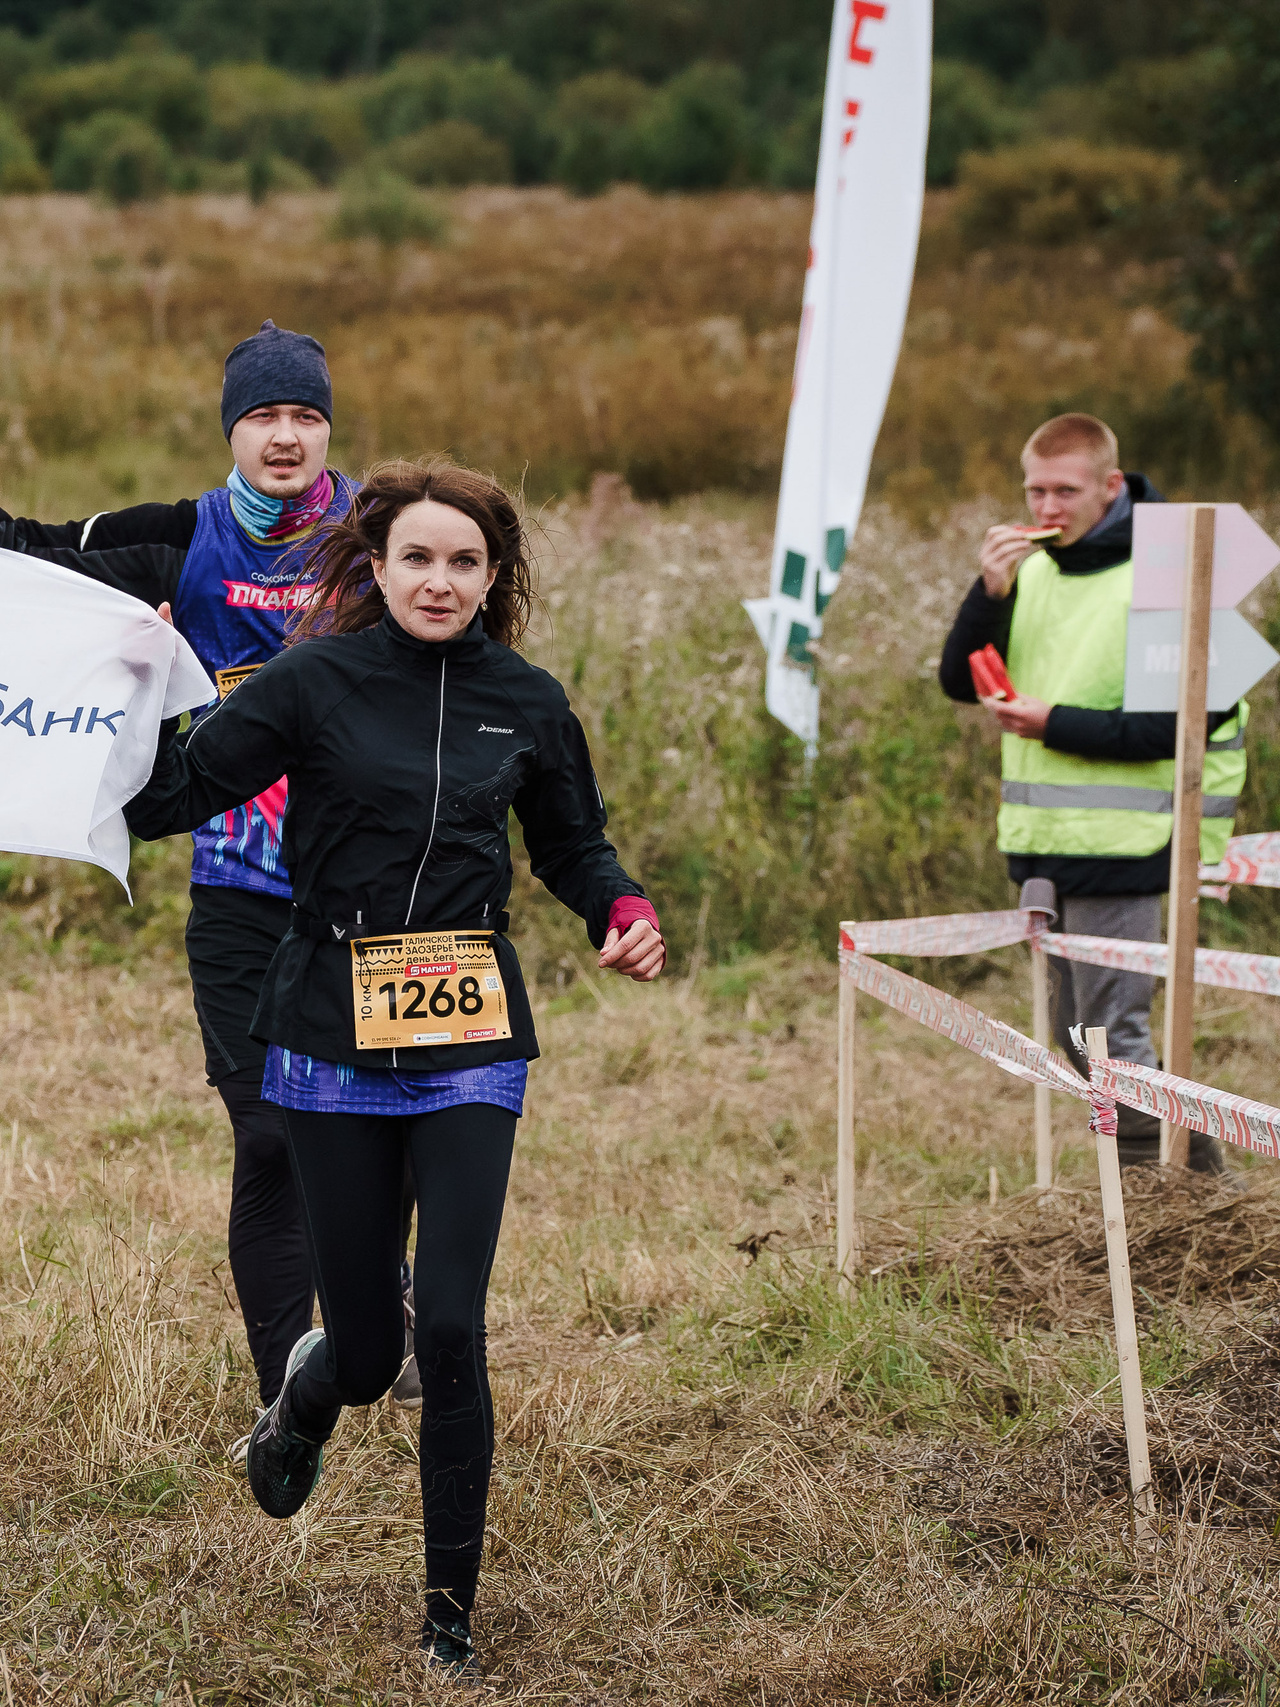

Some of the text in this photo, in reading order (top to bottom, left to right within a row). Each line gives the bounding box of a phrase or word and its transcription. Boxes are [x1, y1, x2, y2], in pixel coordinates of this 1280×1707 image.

[232, 584, 323, 607] ПЛАНБ
[486, 726, 515, 735] DEMIX
[405, 935, 453, 945] ГАЛИЧСКОЕ
[405, 943, 454, 955] ЗАОЗЕРЬЕ
[406, 953, 455, 966] день бега
[421, 965, 452, 974] МАГНИТ
[378, 976, 484, 1021] 1268
[361, 1005, 373, 1022] 10
